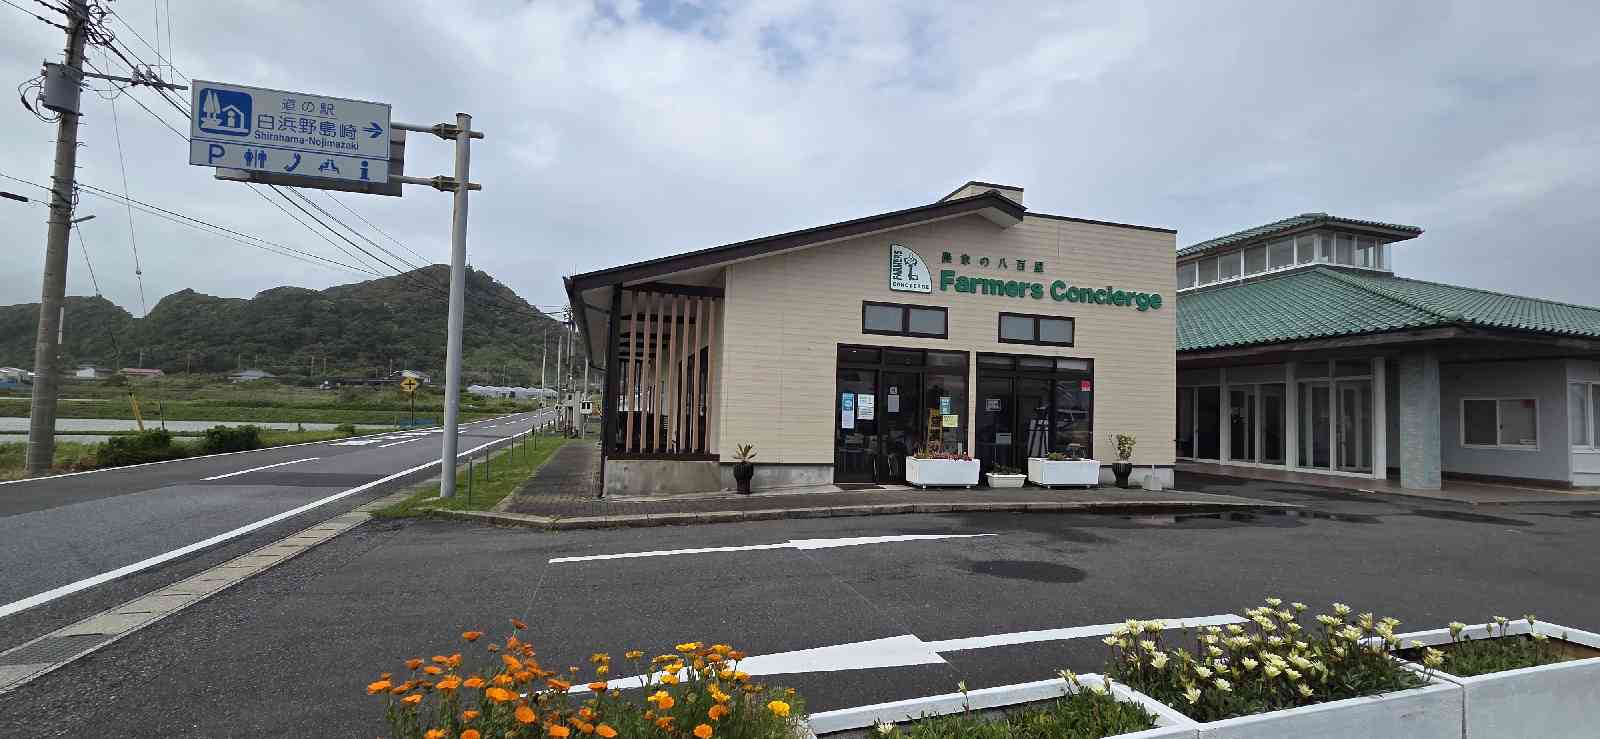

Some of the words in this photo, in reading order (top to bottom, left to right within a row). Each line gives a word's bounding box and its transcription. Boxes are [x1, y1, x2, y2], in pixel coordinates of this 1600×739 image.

[280, 98, 336, 116] 道の駅
[257, 112, 358, 141] 白浜野島崎
[254, 130, 359, 151] Shirahama-Nojimazaki
[208, 143, 226, 164] P
[892, 250, 903, 281] FARMERS
[940, 269, 1044, 300] Farmers
[1050, 280, 1162, 312] Concierge
